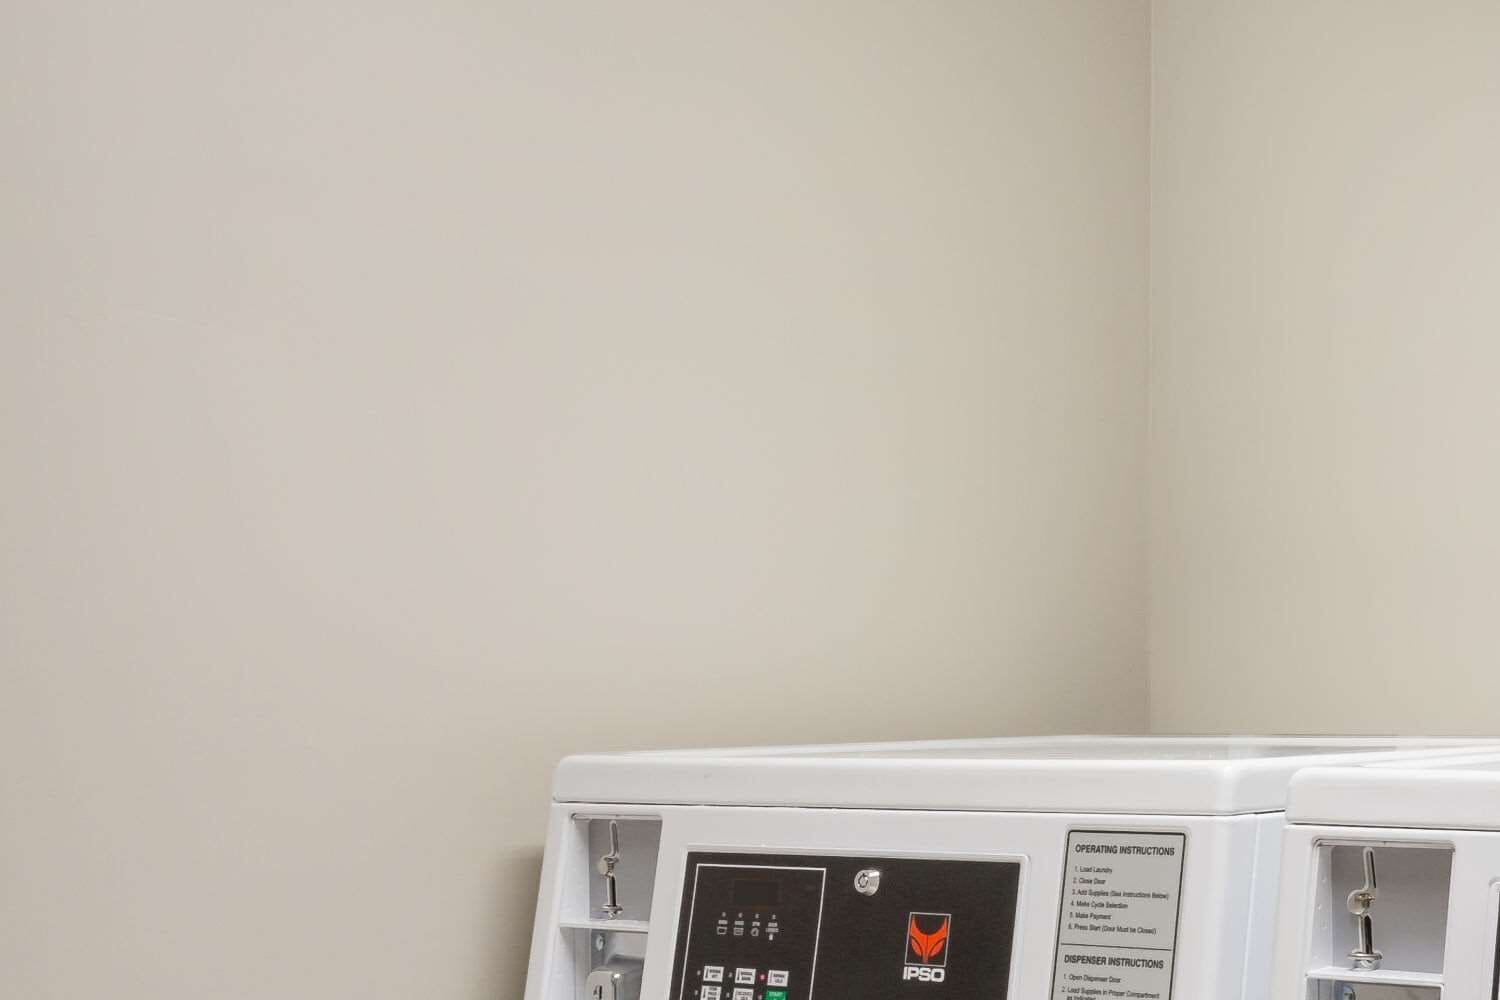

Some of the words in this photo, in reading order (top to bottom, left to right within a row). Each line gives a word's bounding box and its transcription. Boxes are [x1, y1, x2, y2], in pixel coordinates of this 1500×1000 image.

[1075, 844, 1117, 853] OPERATING
[1120, 846, 1174, 855] INSTRUCTIONS
[1064, 955, 1106, 965] DISPENSER
[1108, 958, 1163, 968] INSTRUCTIONS
[903, 966, 945, 982] IPSO
[1084, 974, 1107, 982] Dispenser
[1127, 991, 1160, 999] Compartment
